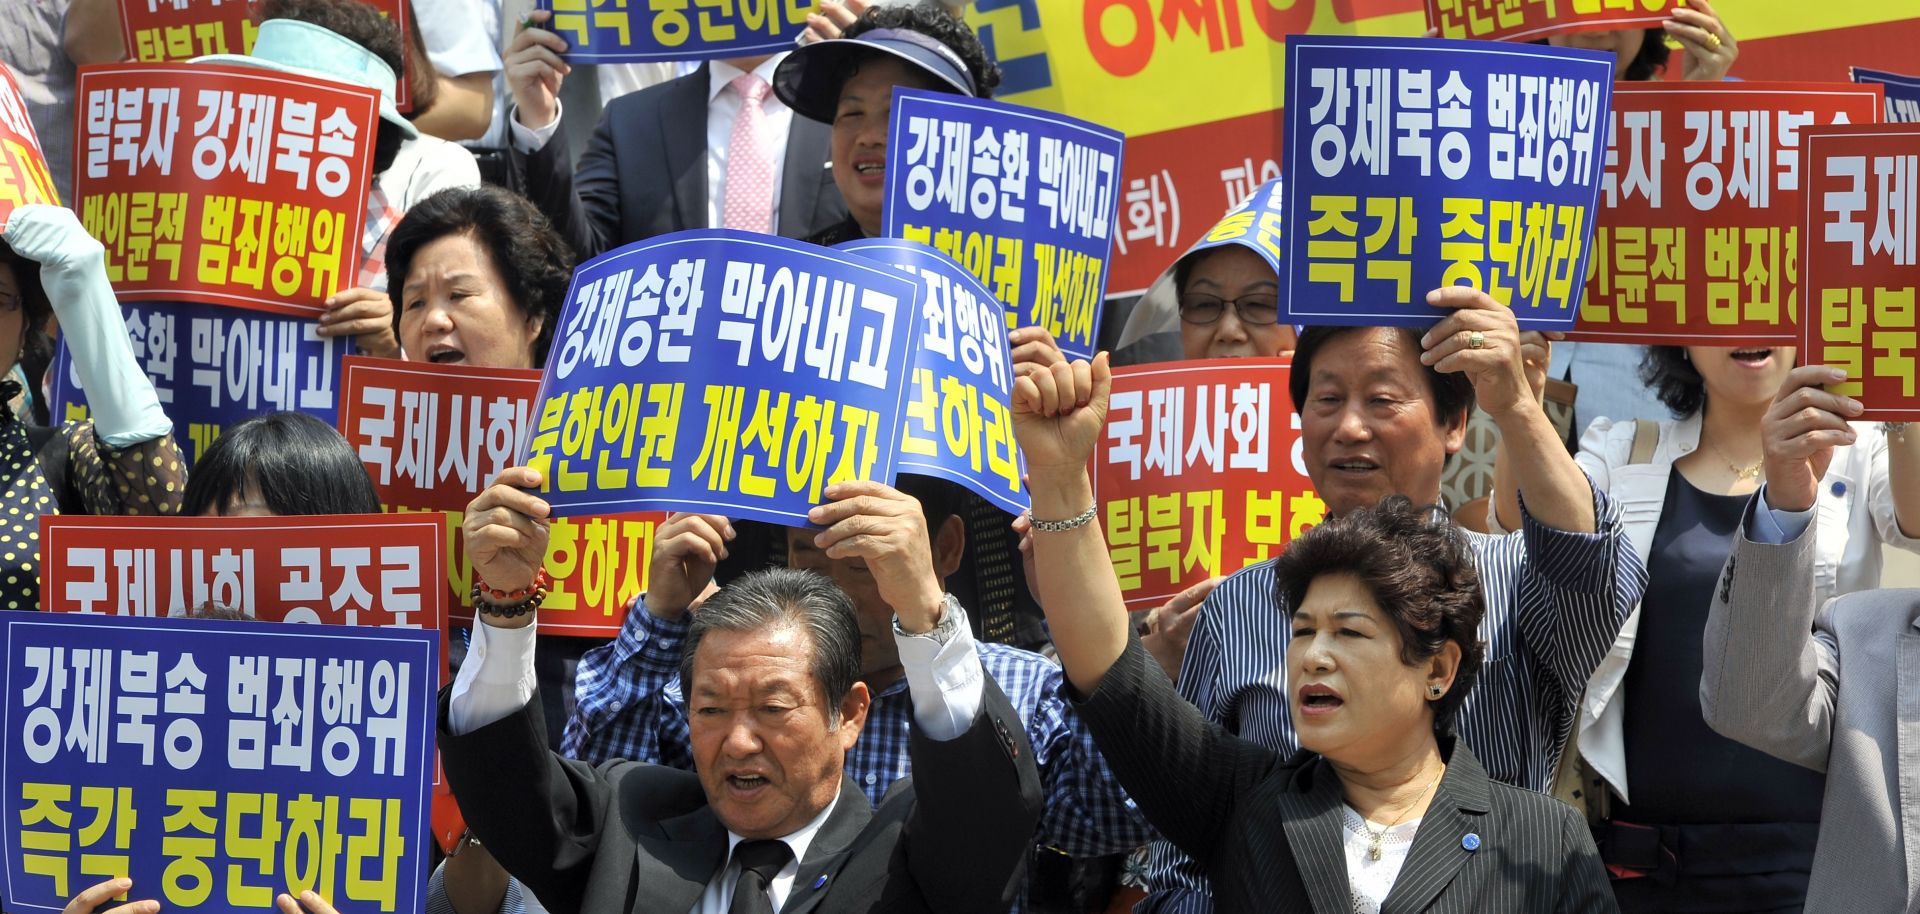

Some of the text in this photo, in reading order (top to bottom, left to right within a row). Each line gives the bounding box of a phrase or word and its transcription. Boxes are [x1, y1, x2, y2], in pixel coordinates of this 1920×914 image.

[87, 87, 180, 178] 탈북자
[192, 89, 358, 198] 강제북송
[906, 116, 1115, 240] 강제송환 막아내고
[1310, 67, 1599, 187] 강제북송 범죄행위
[197, 194, 346, 299] 범죄행위
[1307, 195, 1584, 309] 즉각 중단하라
[1823, 154, 1918, 266] 국제
[556, 258, 898, 390] 강제송환 막아내고
[888, 263, 1008, 396] 죄행위
[1030, 242, 1103, 347] 개선하자
[1579, 226, 1798, 326] 인륜적 범죄
[191, 317, 334, 412] 막아내고
[1821, 286, 1917, 398] 탈북
[358, 386, 529, 493] 국제사회
[527, 382, 880, 505] 북한인권 개선하자
[900, 367, 1021, 494] 단하라
[1107, 382, 1271, 481] 국제사회
[538, 516, 655, 617] 호하자
[1107, 489, 1226, 592] 탈북자
[23, 646, 412, 777] 강제북송 범죄행위
[19, 782, 405, 912] 즉각 중단하라
